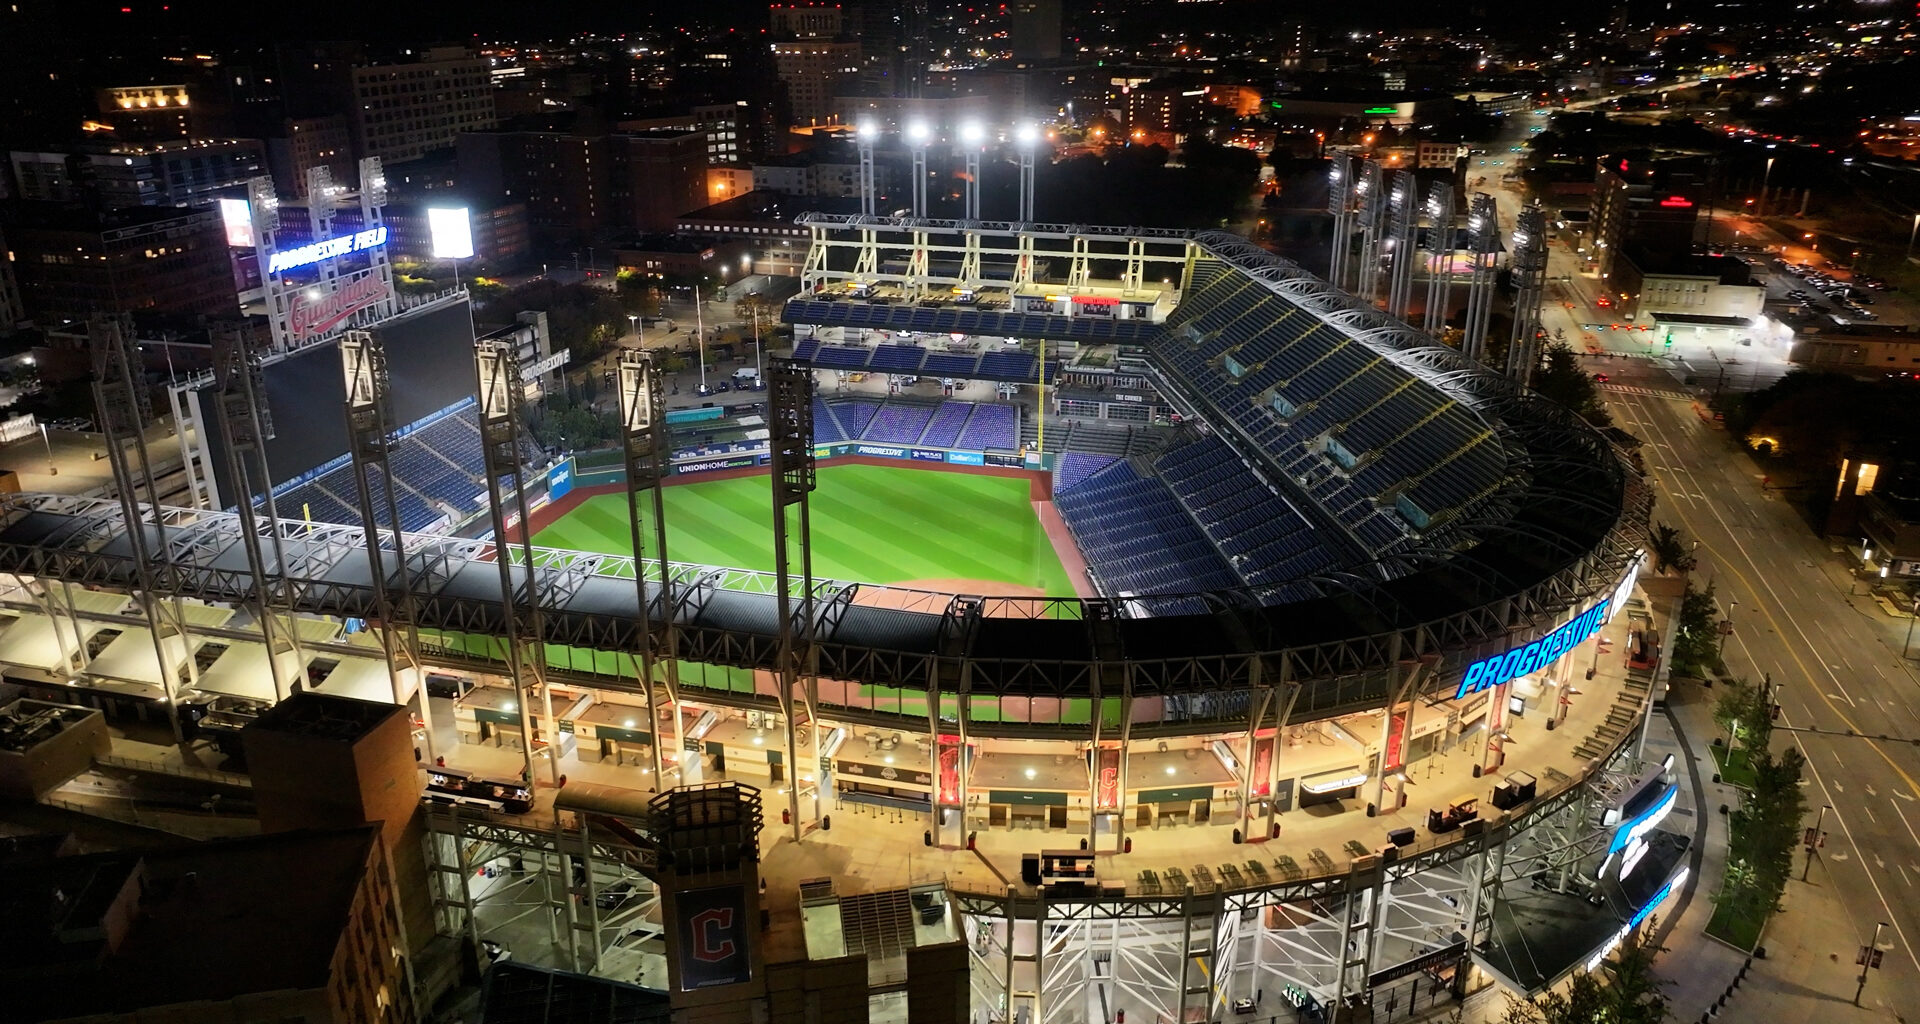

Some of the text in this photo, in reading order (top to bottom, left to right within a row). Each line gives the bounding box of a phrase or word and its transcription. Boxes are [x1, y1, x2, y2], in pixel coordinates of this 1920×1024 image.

[289, 272, 391, 341] Guardians
[520, 348, 571, 382] PROGRESSIVE
[858, 446, 905, 457] PROGRESSIVE
[1456, 598, 1610, 700] PROGRESSIVE
[689, 907, 736, 963] C
